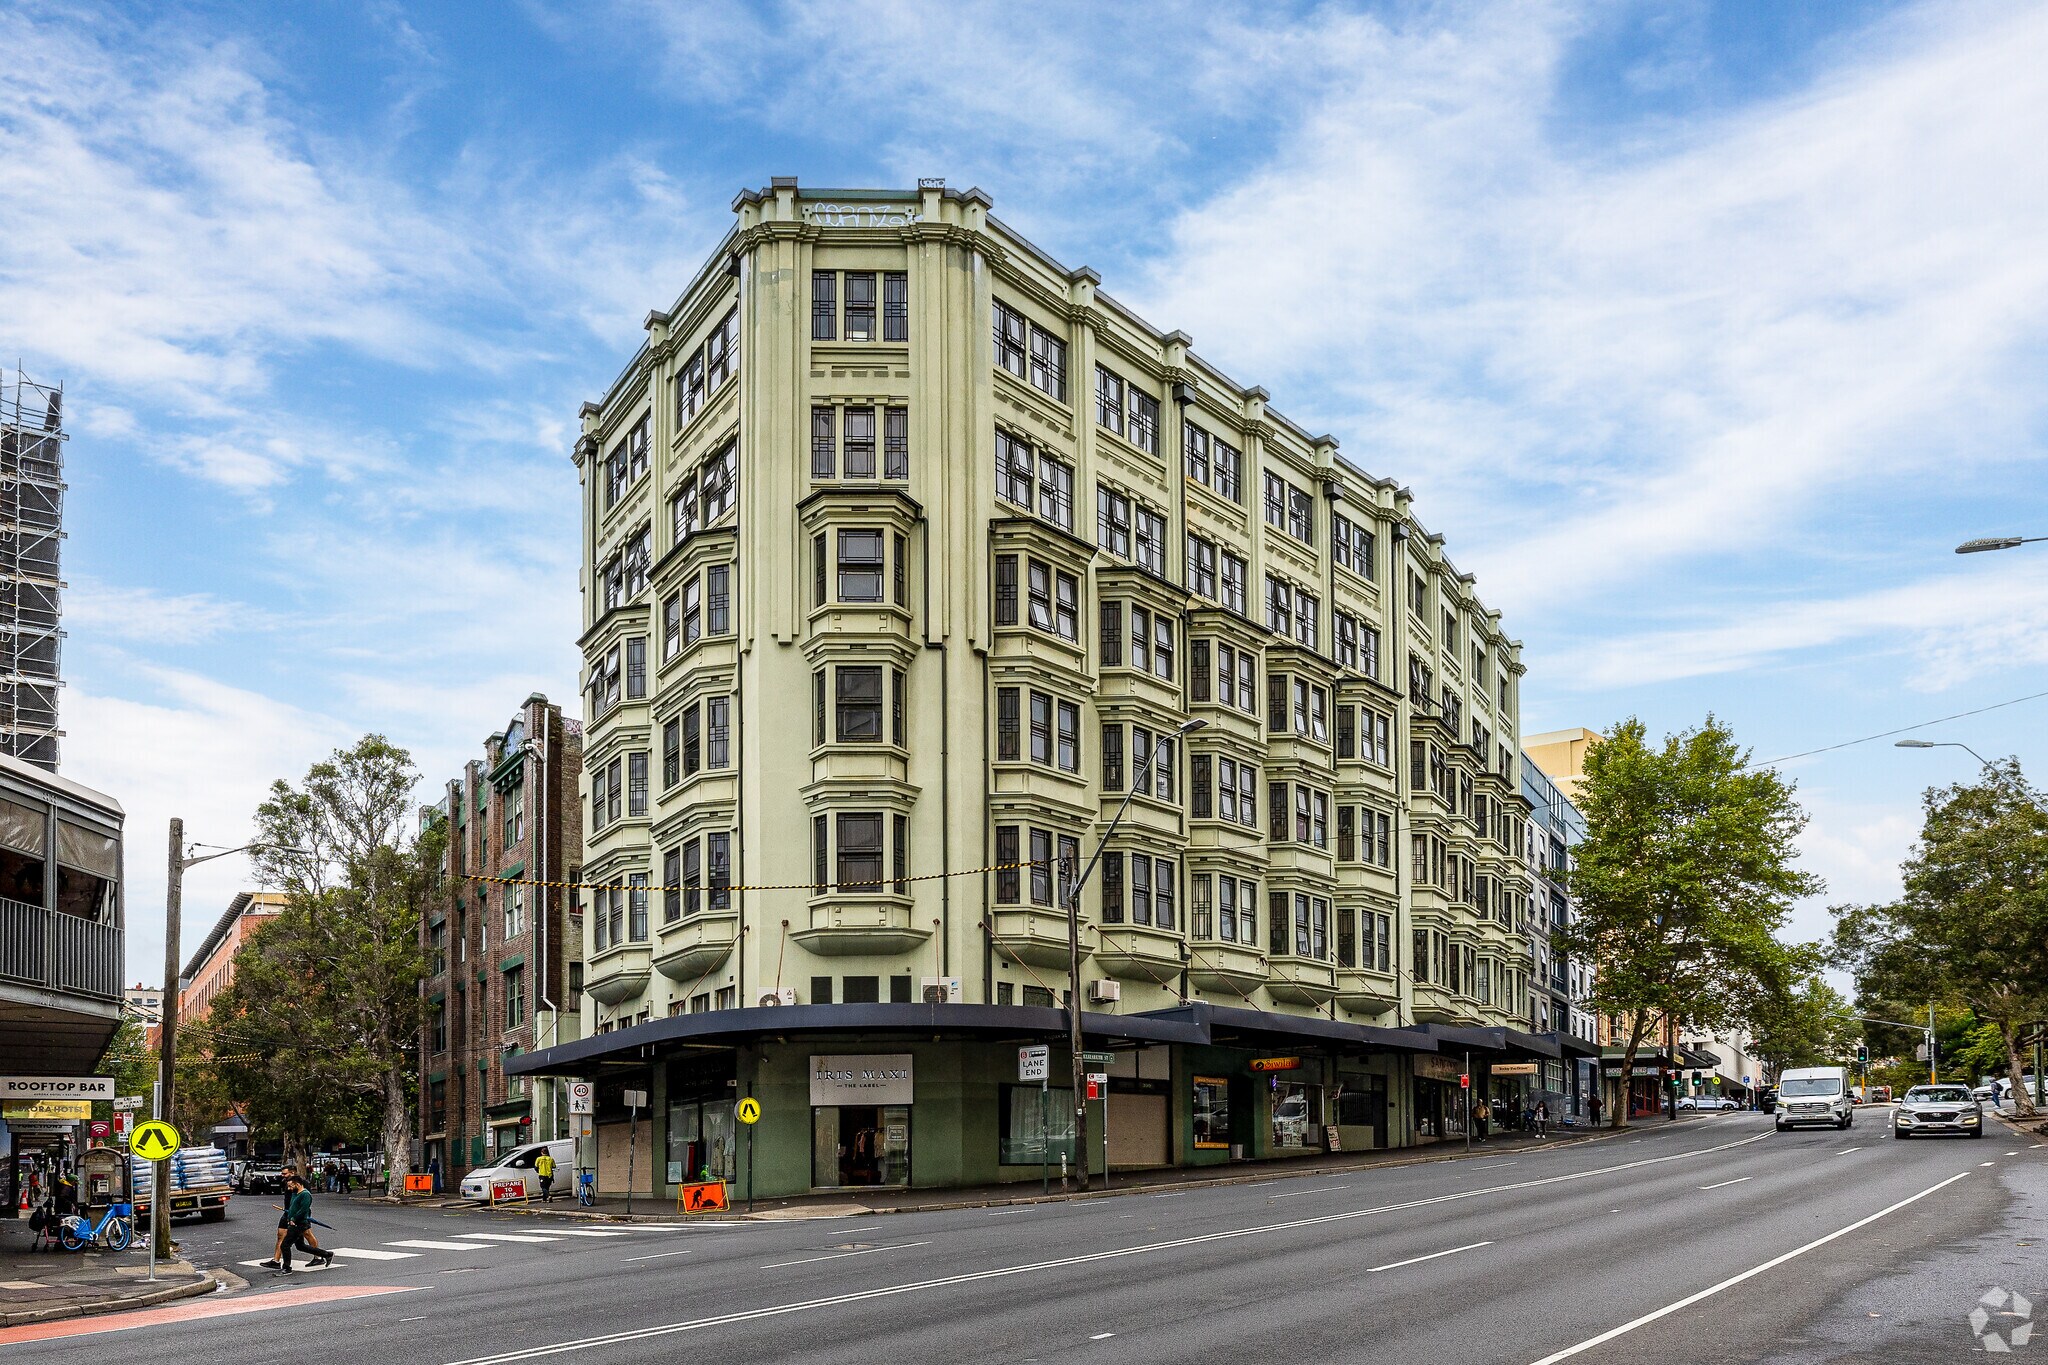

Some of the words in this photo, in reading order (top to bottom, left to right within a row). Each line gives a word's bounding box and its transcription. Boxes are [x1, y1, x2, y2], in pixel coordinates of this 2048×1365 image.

[1022, 1060, 1045, 1068] LANE
[816, 1070, 853, 1080] IRIS
[862, 1069, 907, 1079] MAXI
[8, 1082, 76, 1091] ROOFTOP
[80, 1083, 106, 1091] BAR
